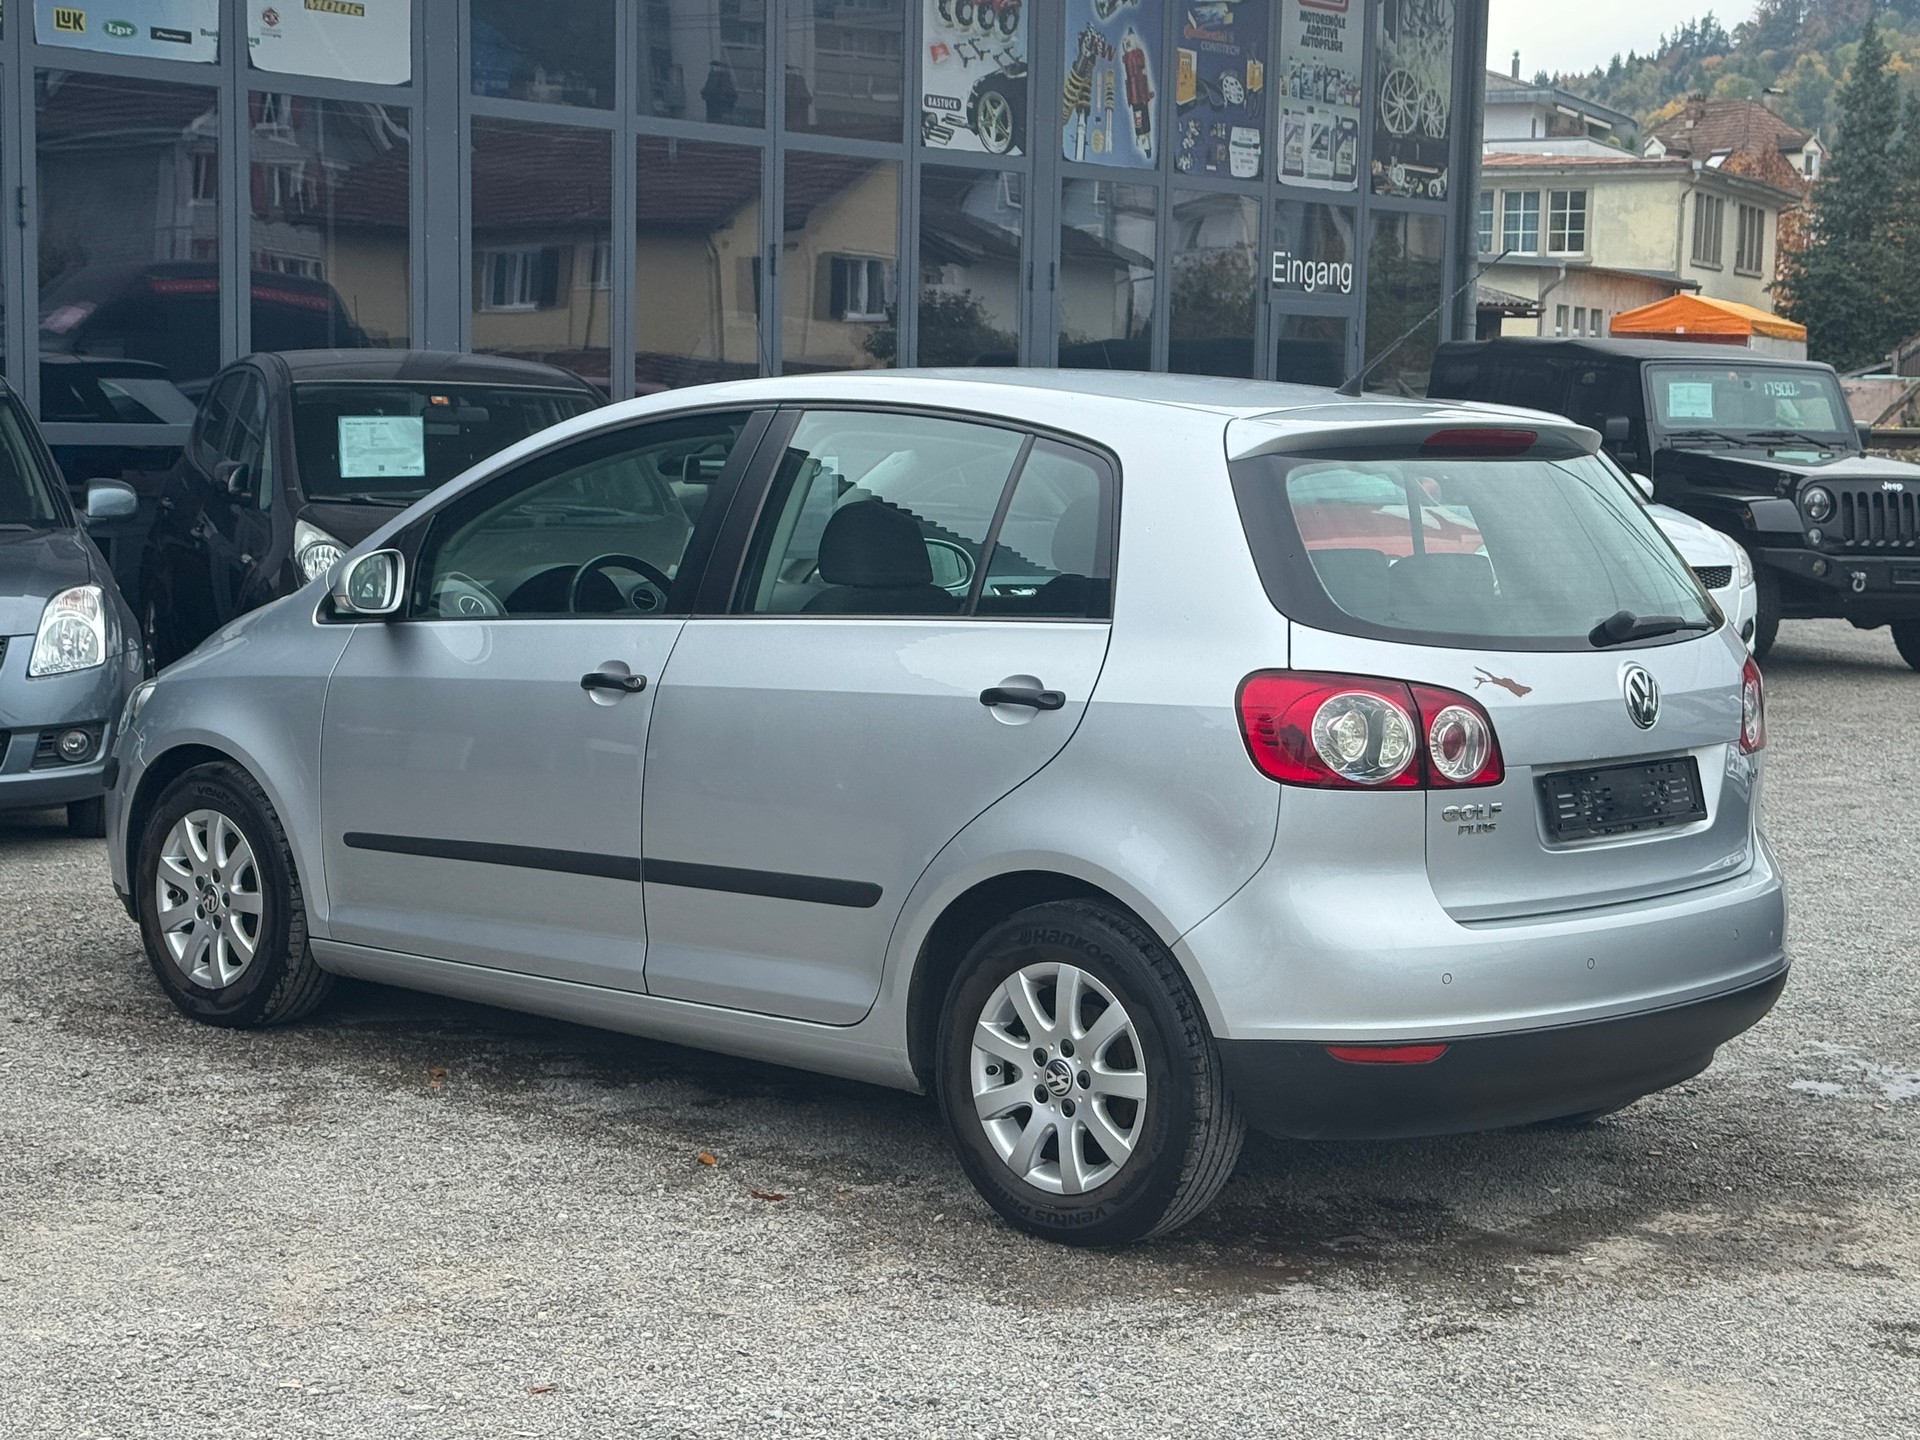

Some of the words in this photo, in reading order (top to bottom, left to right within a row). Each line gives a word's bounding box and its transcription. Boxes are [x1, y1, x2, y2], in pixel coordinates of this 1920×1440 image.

[1306, 23, 1339, 40] ADDITIVE
[1300, 34, 1343, 52] AUTOPFLEGE
[927, 96, 958, 109] BASTUCK
[1272, 251, 1353, 294] Eingang
[1881, 481, 1904, 492] Jeep
[1442, 802, 1503, 822] GOLF
[1458, 822, 1497, 836] PLUS
